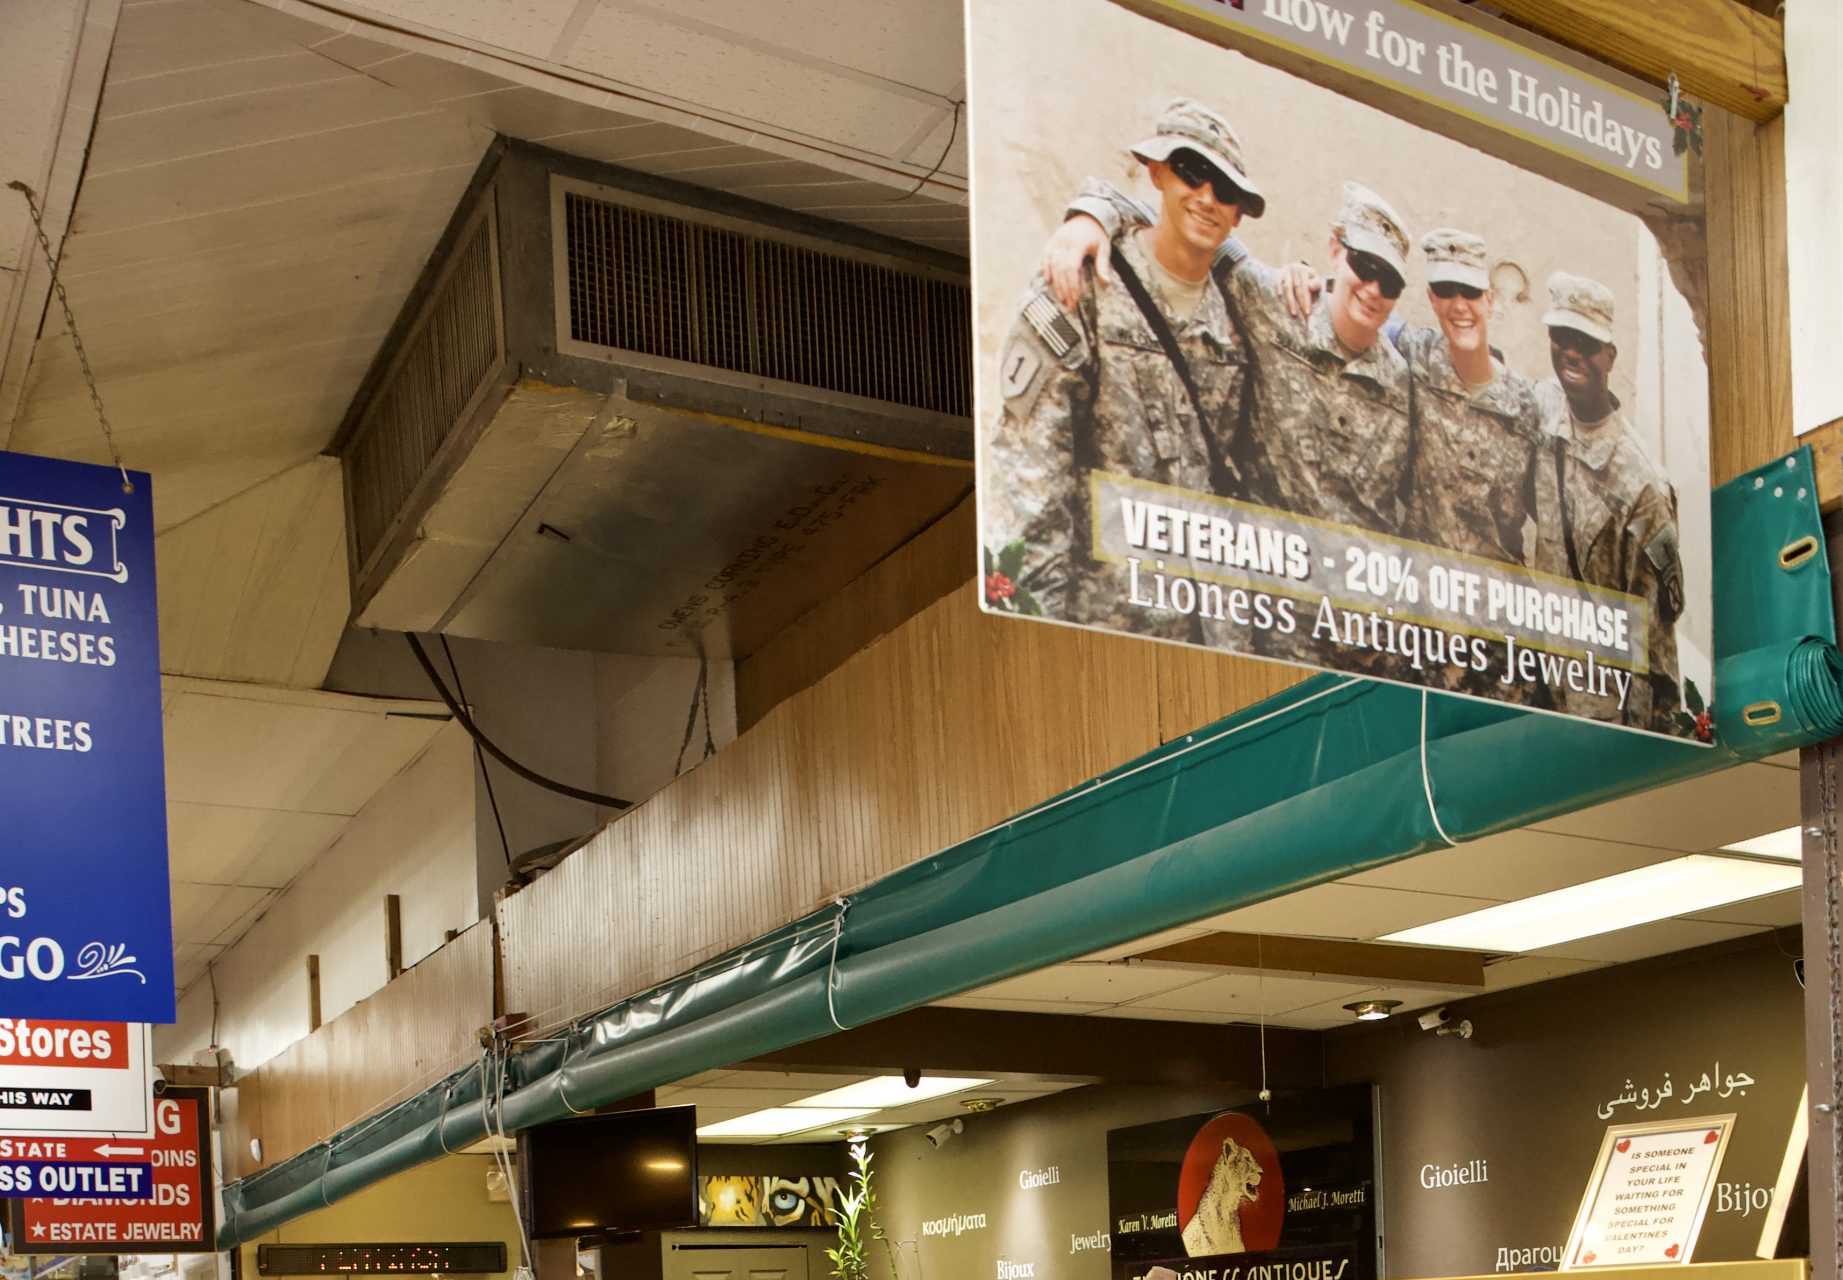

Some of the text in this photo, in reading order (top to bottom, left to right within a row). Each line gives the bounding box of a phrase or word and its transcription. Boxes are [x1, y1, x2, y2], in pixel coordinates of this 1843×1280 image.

[1365, 10, 1426, 75] for
[1436, 42, 1498, 104] the
[1507, 68, 1663, 170] Holidays
[1120, 497, 1311, 582] VETERANS
[1345, 546, 1419, 604] 20%
[1428, 565, 1481, 617] OFF
[1487, 577, 1630, 652] PURCHASE
[17, 583, 112, 624] TUNA
[0, 624, 116, 667] HEESES
[1126, 556, 1632, 711] Lioness Antiques Jewelry
[0, 1018, 113, 1060] Stores
[31, 1092, 74, 1106] WAY
[151, 1149, 197, 1168] OINS
[1631, 1147, 1696, 1160] IS SOMEONE
[38, 1166, 144, 1194] OUTLET
[1018, 1165, 1061, 1191] Gioielli
[1420, 1159, 1489, 1189] Gioielli
[1628, 1162, 1687, 1174] SPECIAL IN
[1627, 1176, 1681, 1187] YOUR LIFE
[1288, 1192, 1321, 1212] Michael
[1331, 1187, 1365, 1206] Moretti
[1615, 1189, 1684, 1201] WAITING FOR
[1614, 1203, 1676, 1215] SOMETHING
[1653, 1217, 1674, 1225] FOR
[49, 1222, 202, 1242] ESTATE JEWELRY
[1118, 1219, 1140, 1234] Karen
[1150, 1211, 1178, 1230] Moretti
[1070, 1230, 1111, 1254] Jewelry
